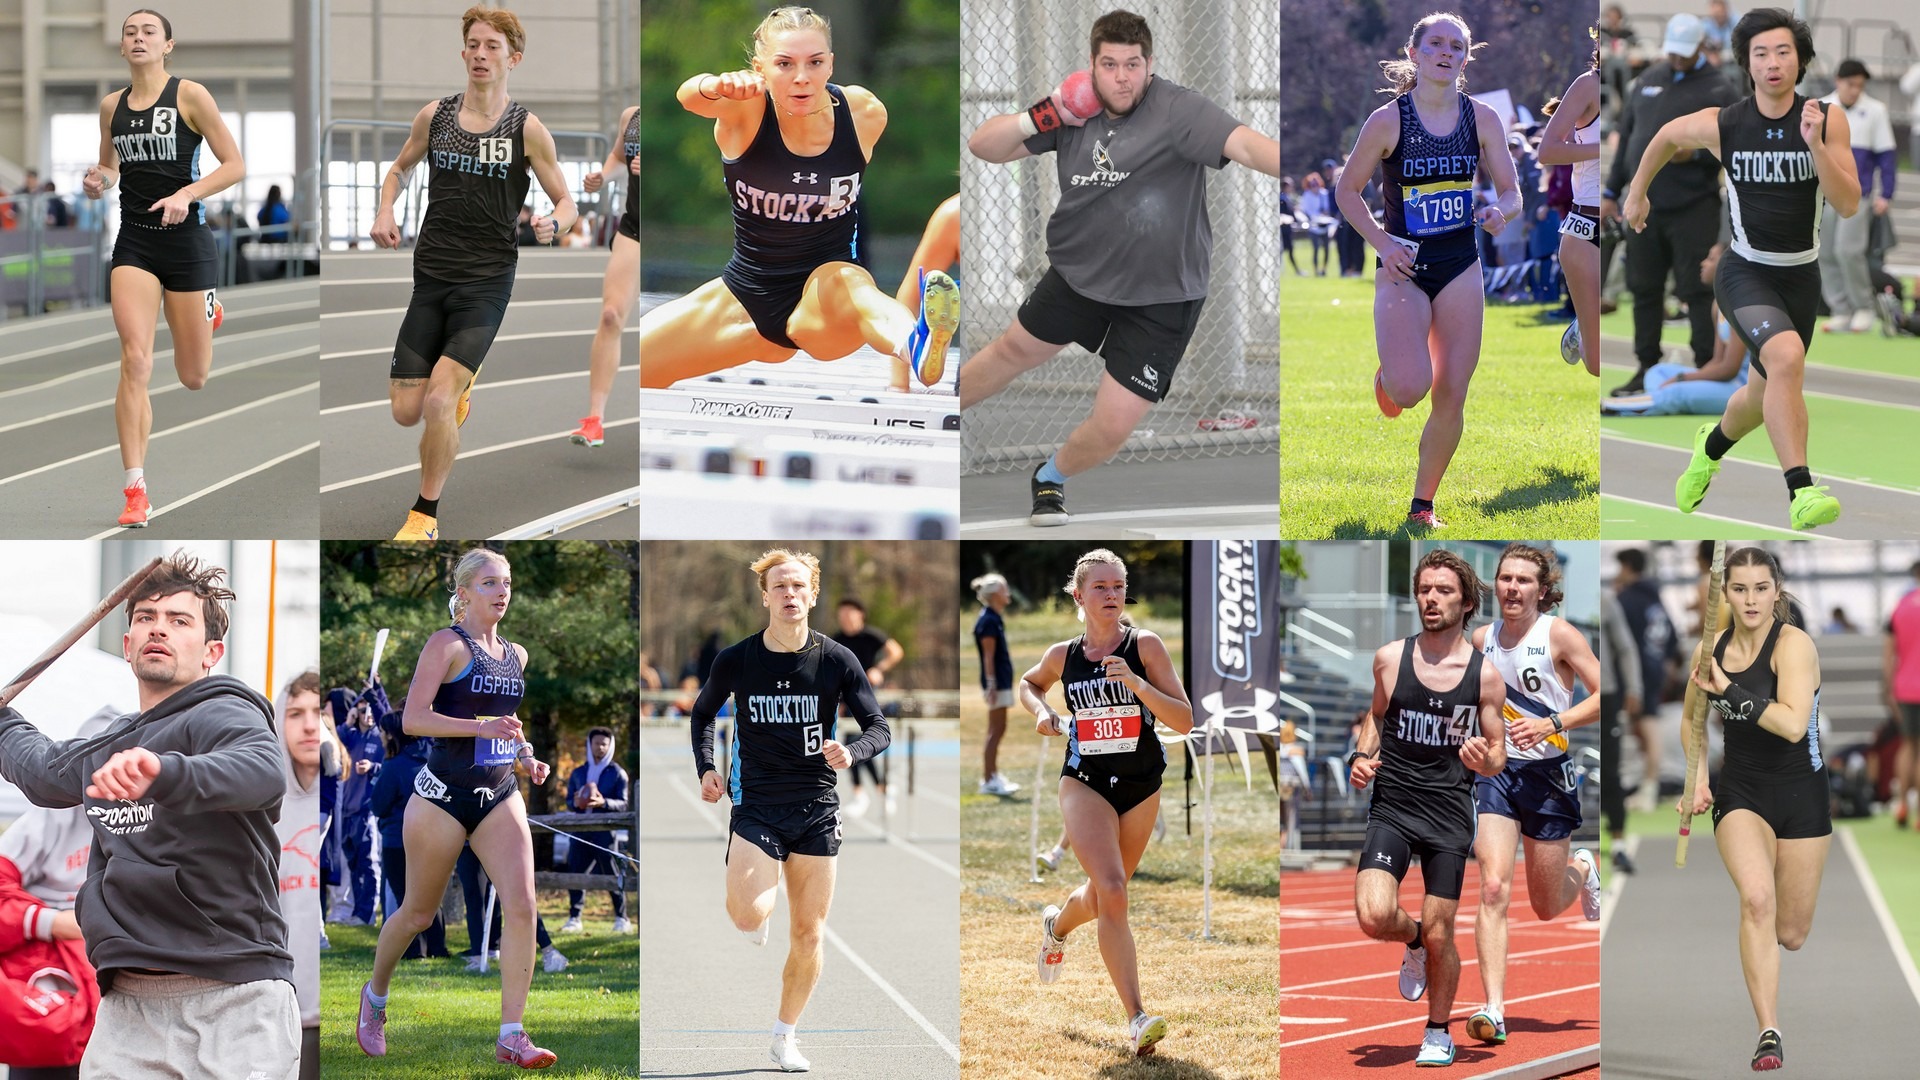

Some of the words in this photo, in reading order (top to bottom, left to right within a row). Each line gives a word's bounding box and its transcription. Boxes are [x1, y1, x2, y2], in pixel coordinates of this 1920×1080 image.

[155, 109, 173, 135] 3
[482, 139, 508, 161] 15
[1070, 171, 1131, 186] STKTON
[1731, 151, 1818, 183] STOCKTON
[735, 180, 852, 223] STOCKT
[829, 179, 853, 213] 3
[1419, 196, 1464, 224] 1799
[206, 291, 214, 318] 3
[1527, 646, 1546, 656] TCNJ
[1522, 667, 1542, 693] 6
[748, 695, 819, 723] STOCKTON
[1452, 707, 1472, 735] 4
[807, 726, 821, 753] 5
[1093, 718, 1123, 739] 303
[1397, 708, 1465, 746] STOCKT
[1566, 762, 1576, 789] 6
[87, 804, 155, 825] STOCKTON
[249, 1070, 267, 1079] NIKE
